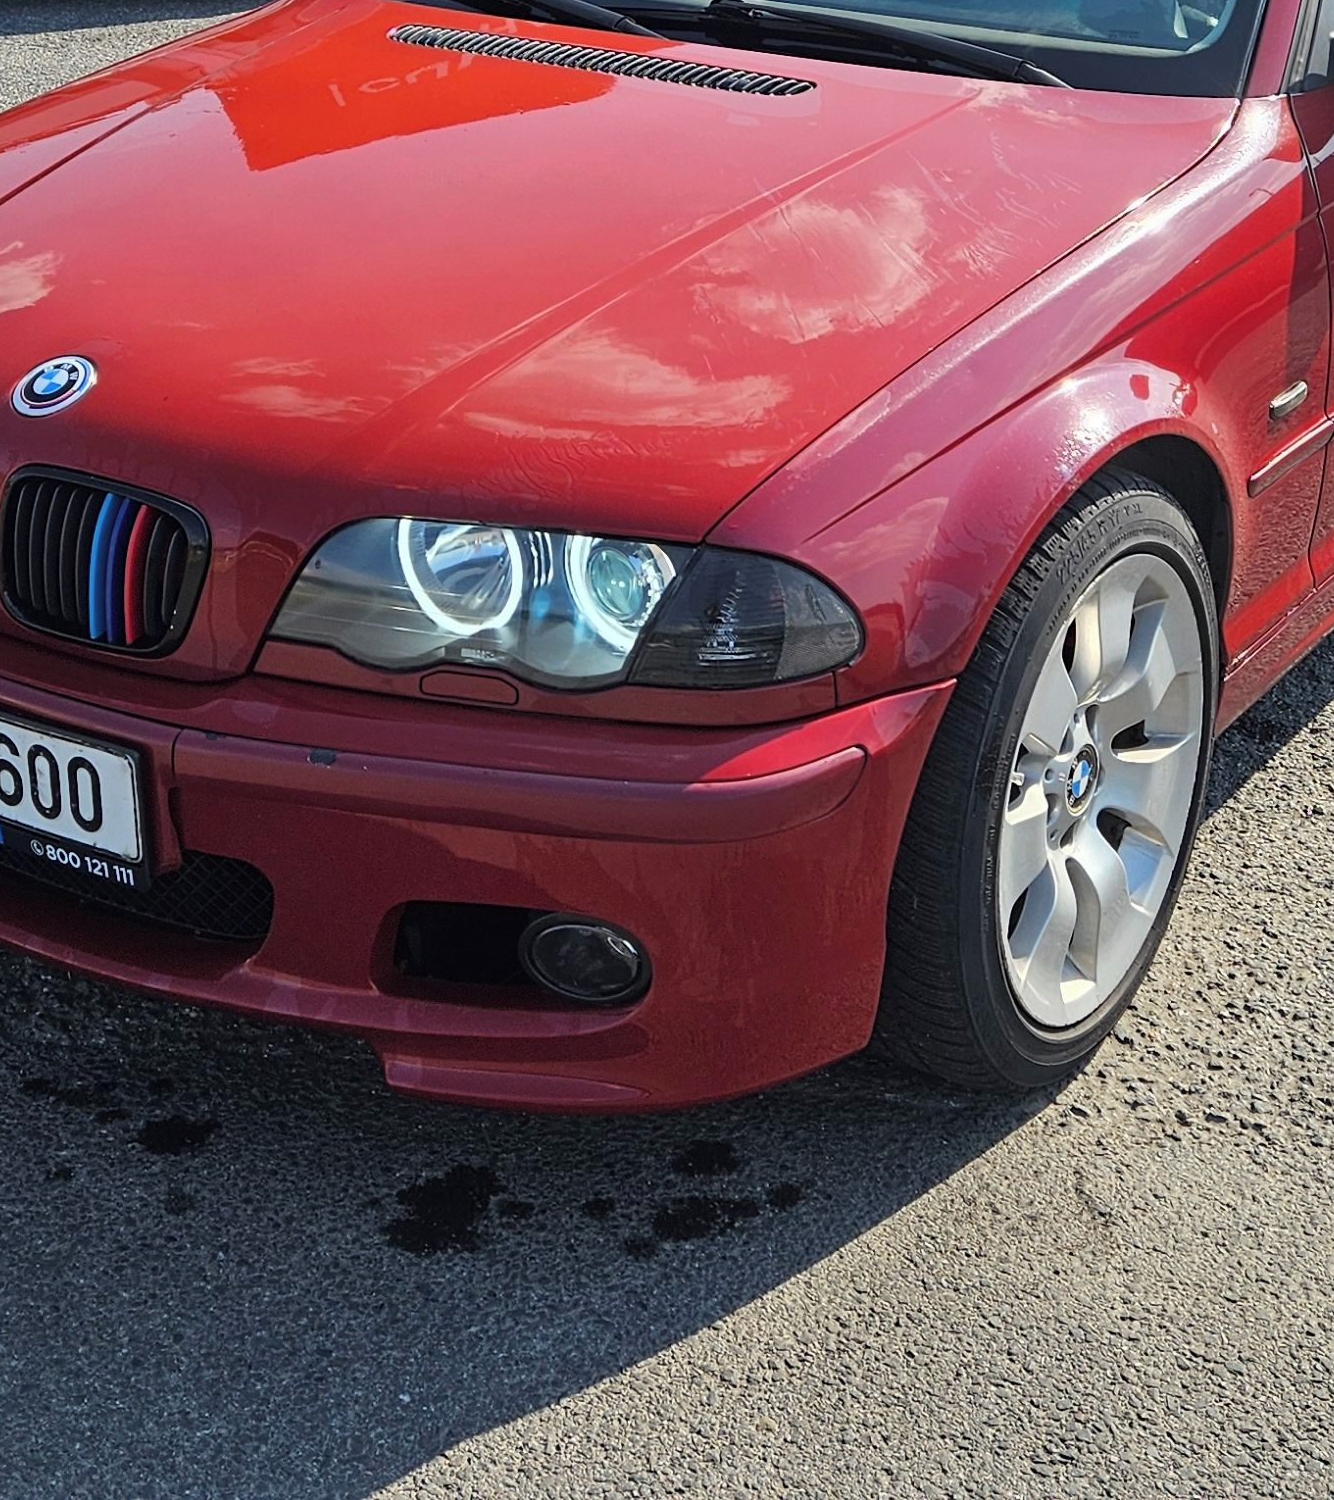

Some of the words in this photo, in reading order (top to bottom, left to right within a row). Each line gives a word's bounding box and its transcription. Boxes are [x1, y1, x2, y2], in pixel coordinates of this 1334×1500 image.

[45, 845, 81, 870] 800
[84, 857, 110, 879] 121
[112, 864, 136, 887] 111
